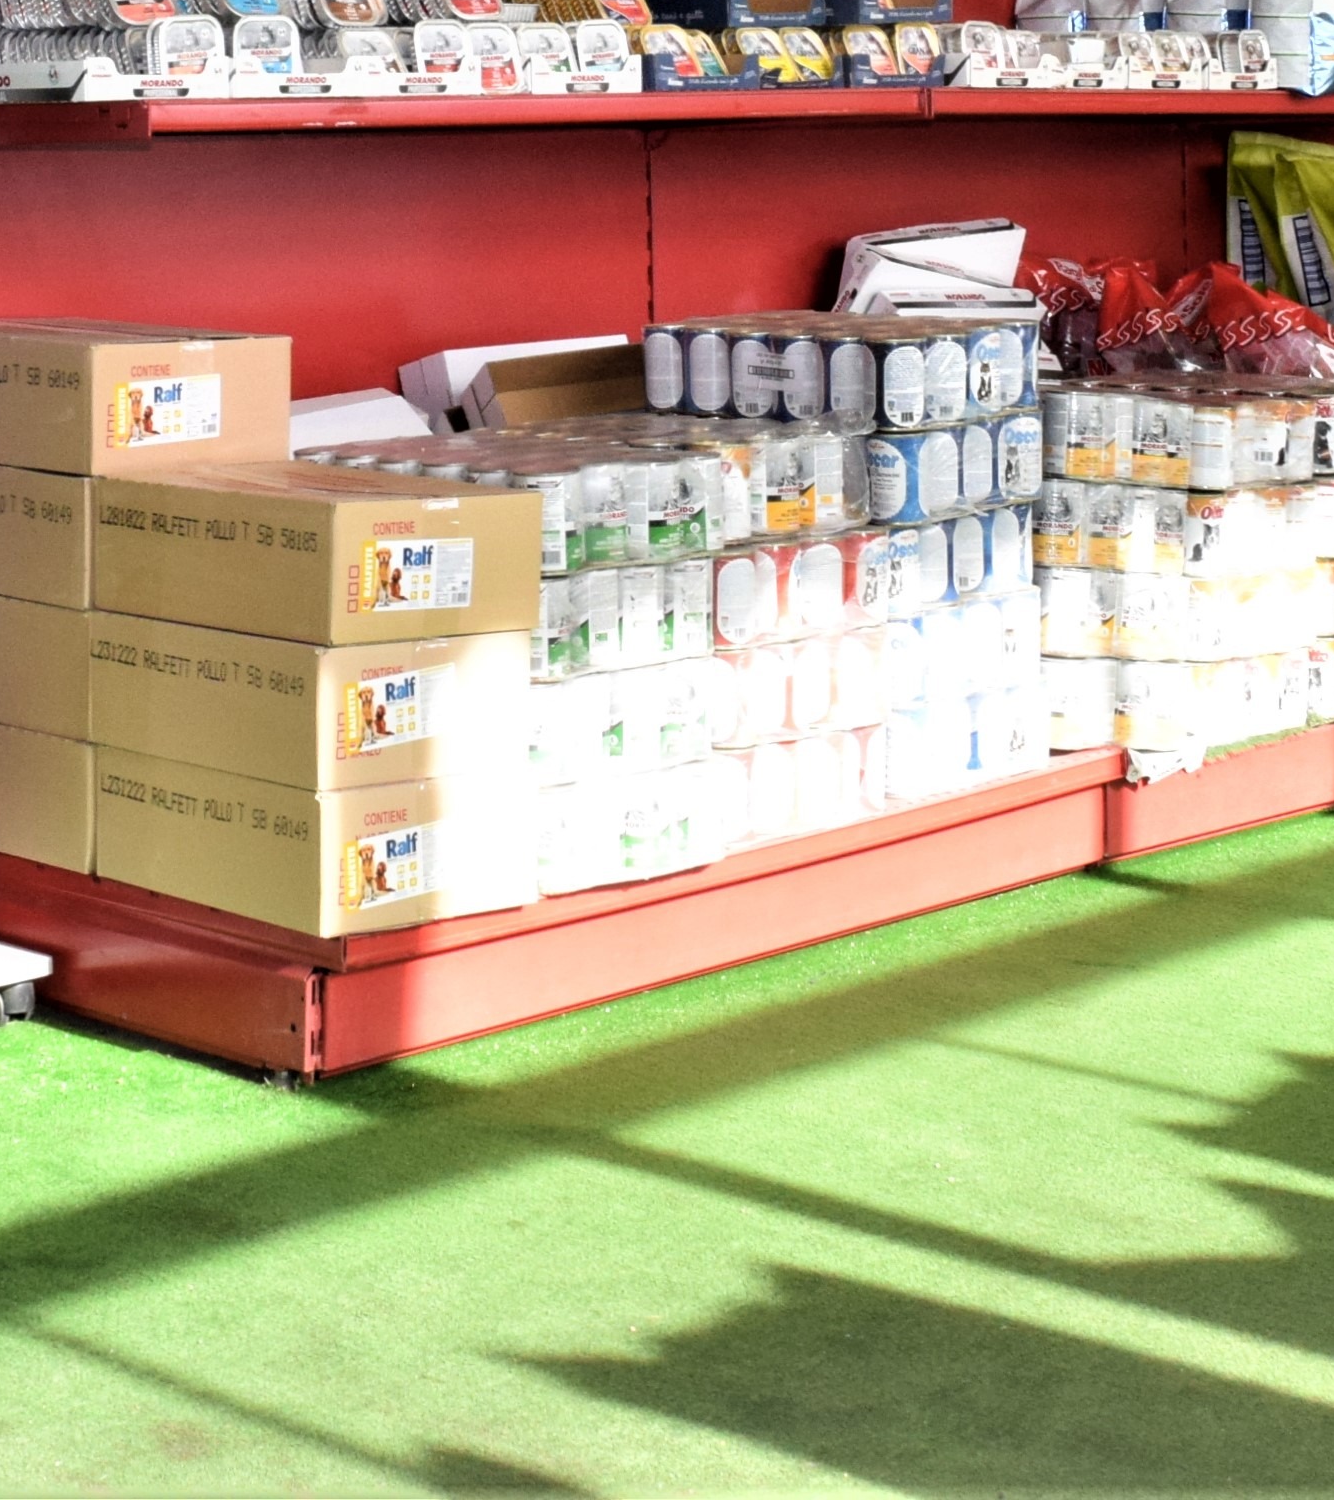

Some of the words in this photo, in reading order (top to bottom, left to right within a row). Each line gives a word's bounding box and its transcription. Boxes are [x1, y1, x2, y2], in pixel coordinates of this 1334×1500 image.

[140, 79, 184, 88] MORANDO
[130, 363, 171, 378] CONTIENE
[153, 383, 183, 405] Ralf
[372, 520, 416, 536] CONTIENE
[402, 544, 433, 568] Ralf
[384, 675, 417, 701] Ralf
